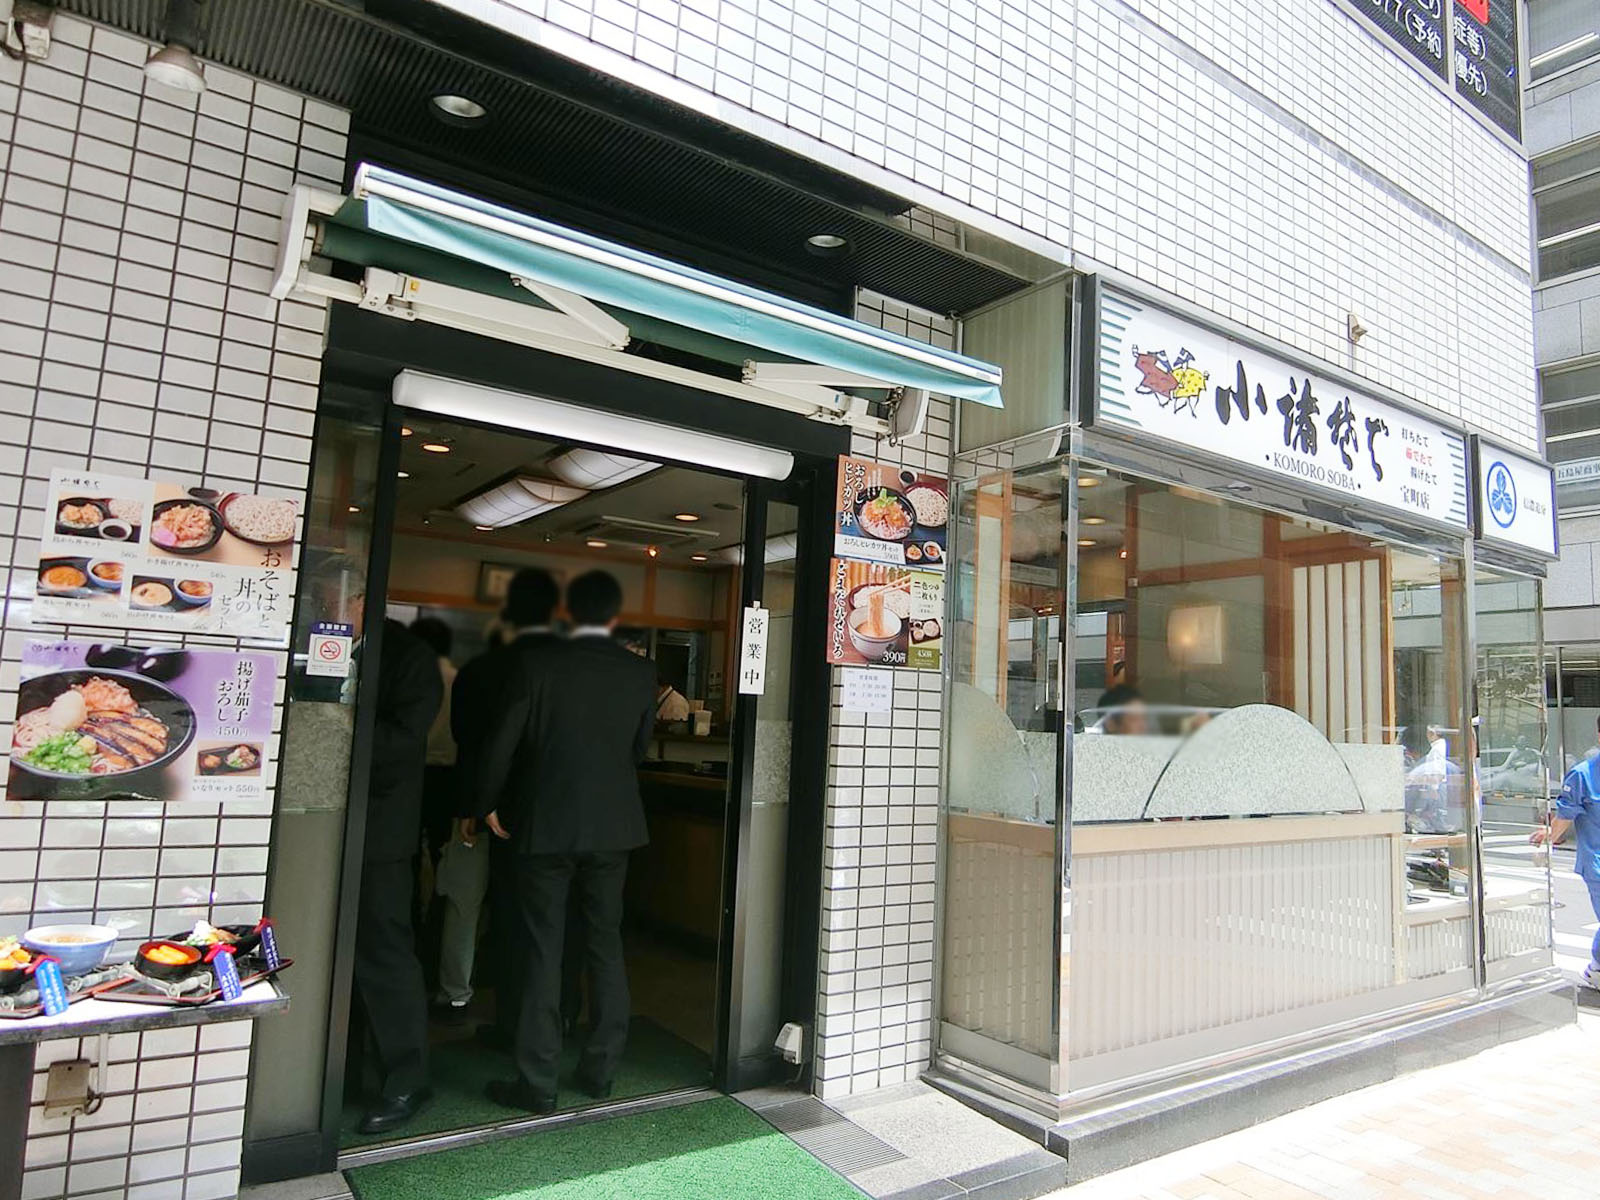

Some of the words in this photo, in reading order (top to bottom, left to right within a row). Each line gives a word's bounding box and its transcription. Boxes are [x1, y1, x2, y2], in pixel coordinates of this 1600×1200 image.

[853, 463, 867, 505] おろし
[1274, 452, 1325, 481] KOMORO
[1327, 469, 1355, 491] SOBA
[840, 460, 854, 528] ヒレカツ丼
[234, 577, 256, 613] 丼の
[260, 548, 281, 630] おそばと
[219, 595, 232, 630] セット
[743, 616, 764, 686] 営業中
[882, 651, 907, 663] 390円
[217, 680, 234, 721] おろし
[234, 661, 254, 722] 揚げ茄子
